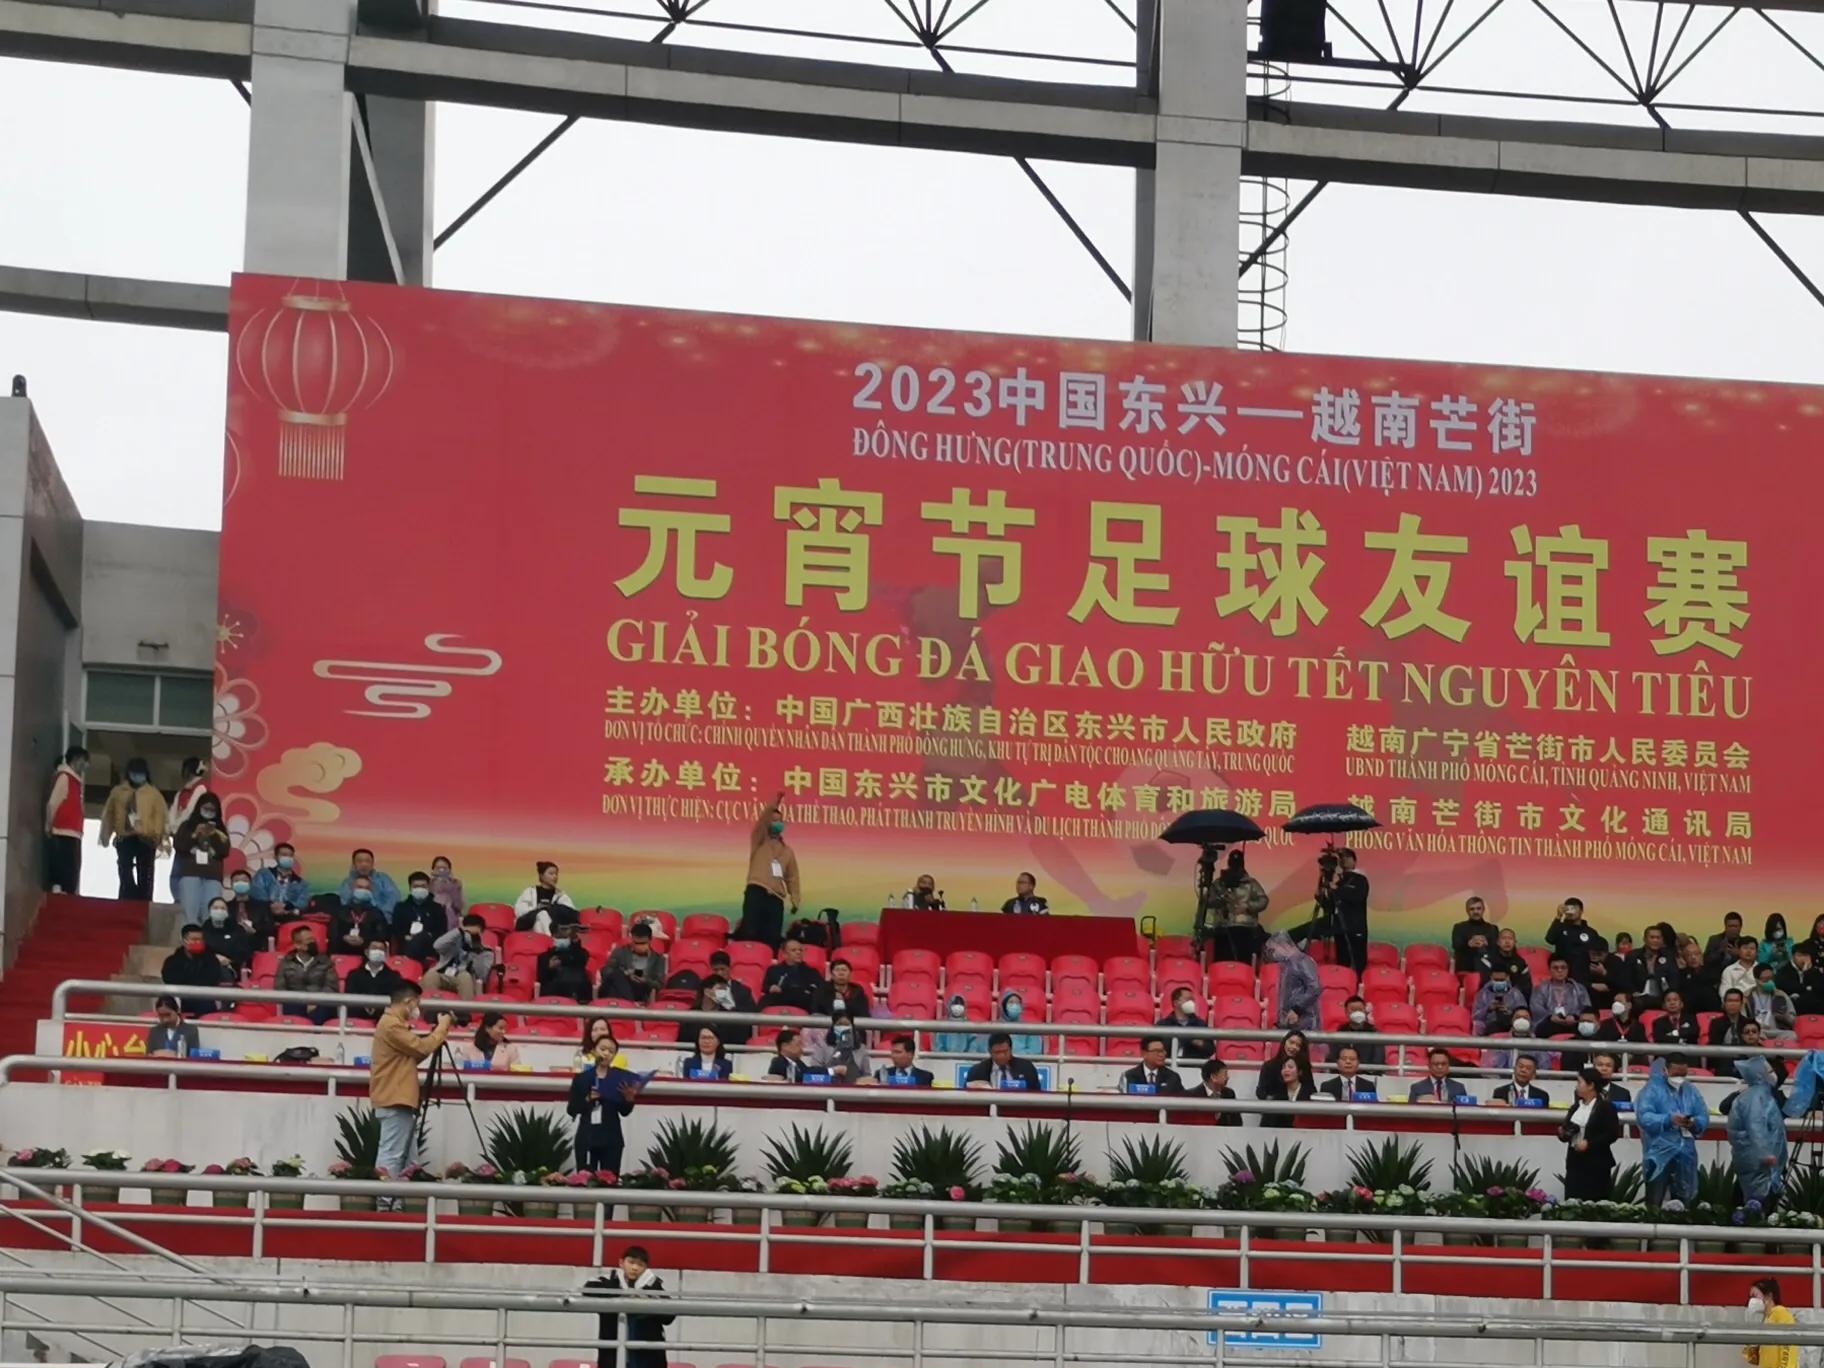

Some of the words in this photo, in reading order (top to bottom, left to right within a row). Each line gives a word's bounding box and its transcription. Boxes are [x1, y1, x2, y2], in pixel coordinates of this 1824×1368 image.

[853, 420, 927, 460] ĐÔNG
[1417, 462, 1482, 499] NAM)
[1489, 466, 1537, 496] 2023
[613, 474, 1751, 659] 元宵节足球友谊赛
[607, 610, 731, 667] GIẢI
[746, 617, 903, 676] BÓNG
[917, 627, 991, 682] ĐÁ
[1006, 642, 1144, 690] GIAO
[1158, 642, 1272, 696] HỮU
[1288, 647, 1389, 700] TẾT
[1401, 653, 1619, 714] NGUYÊN
[1633, 659, 1752, 719] TIÊU
[776, 694, 1297, 750] 中国广西壮族自治区东兴市人民政府
[1346, 724, 1750, 769] 越南广宁省芒街市人民委员会
[1223, 751, 1261, 774] TRUNG
[1345, 756, 1384, 777] UBND
[1720, 773, 1751, 793] NAM
[1509, 837, 1532, 857] TIN
[1722, 845, 1752, 865] NAM
